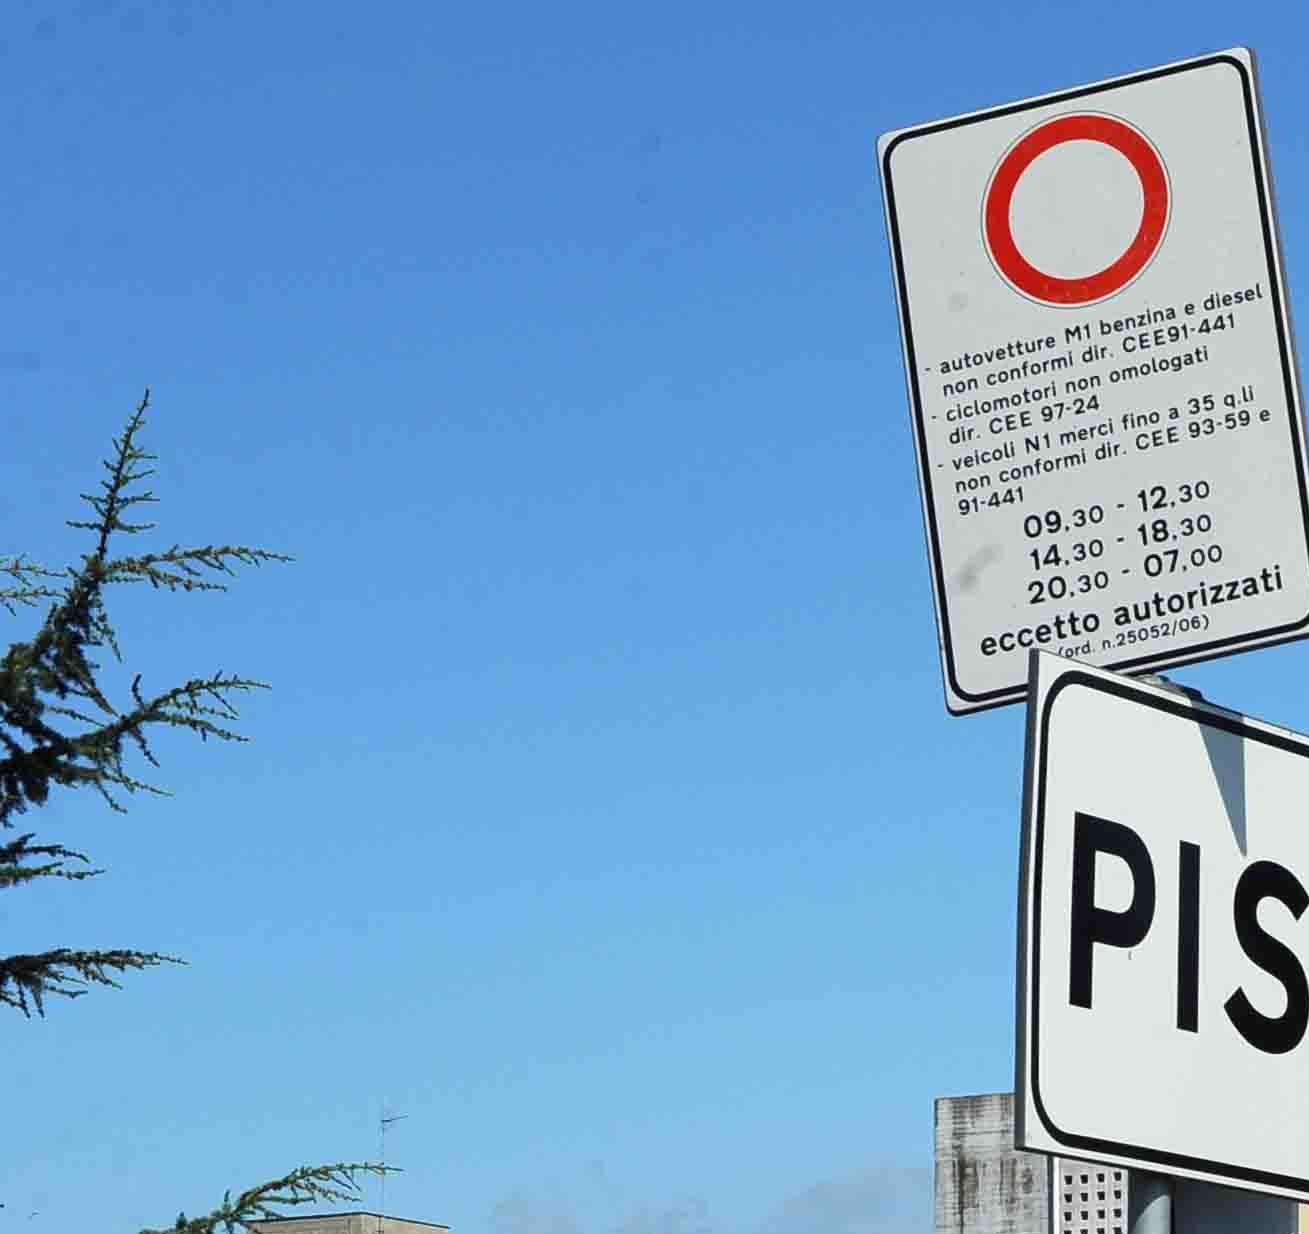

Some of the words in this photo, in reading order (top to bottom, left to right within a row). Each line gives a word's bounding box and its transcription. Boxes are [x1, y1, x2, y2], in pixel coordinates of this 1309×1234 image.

[939, 336, 1056, 375] autovetture
[1064, 323, 1091, 345] M1
[1099, 307, 1177, 336] benzina
[1183, 303, 1195, 316] e
[1203, 282, 1264, 312] diesel
[942, 377, 979, 398] non
[986, 350, 1074, 386] conformi
[1081, 344, 1114, 364] dir.
[946, 380, 1057, 422] ciclomotori
[1065, 375, 1102, 394] non
[1108, 345, 1209, 384] omologati
[948, 425, 981, 445] dir.
[988, 410, 1033, 435] CEE
[1040, 394, 1100, 423] 97-24
[951, 440, 1016, 471] veicoli
[1024, 432, 1051, 455] N1
[1059, 417, 1114, 446] merci
[1121, 411, 1160, 431] fino
[1168, 407, 1180, 420] a
[1187, 394, 1215, 415] 35
[1223, 385, 1254, 409] q.li
[955, 474, 991, 494] non
[998, 447, 1087, 483] conformi
[1094, 441, 1127, 461] dir.
[1135, 425, 1180, 451] CEE
[1188, 409, 1251, 439] 93-59
[1259, 409, 1271, 423] e
[957, 485, 1024, 516] 91-441
[1023, 504, 1104, 539] 09.30
[1137, 480, 1210, 513] 12.30
[1029, 538, 1104, 571] 14.30
[1137, 513, 1212, 547] 18.30
[1027, 570, 1109, 605] 20.30
[1143, 544, 1223, 578] 07.00
[980, 610, 1100, 657] eccetto
[1113, 564, 1283, 627] autorizzati
